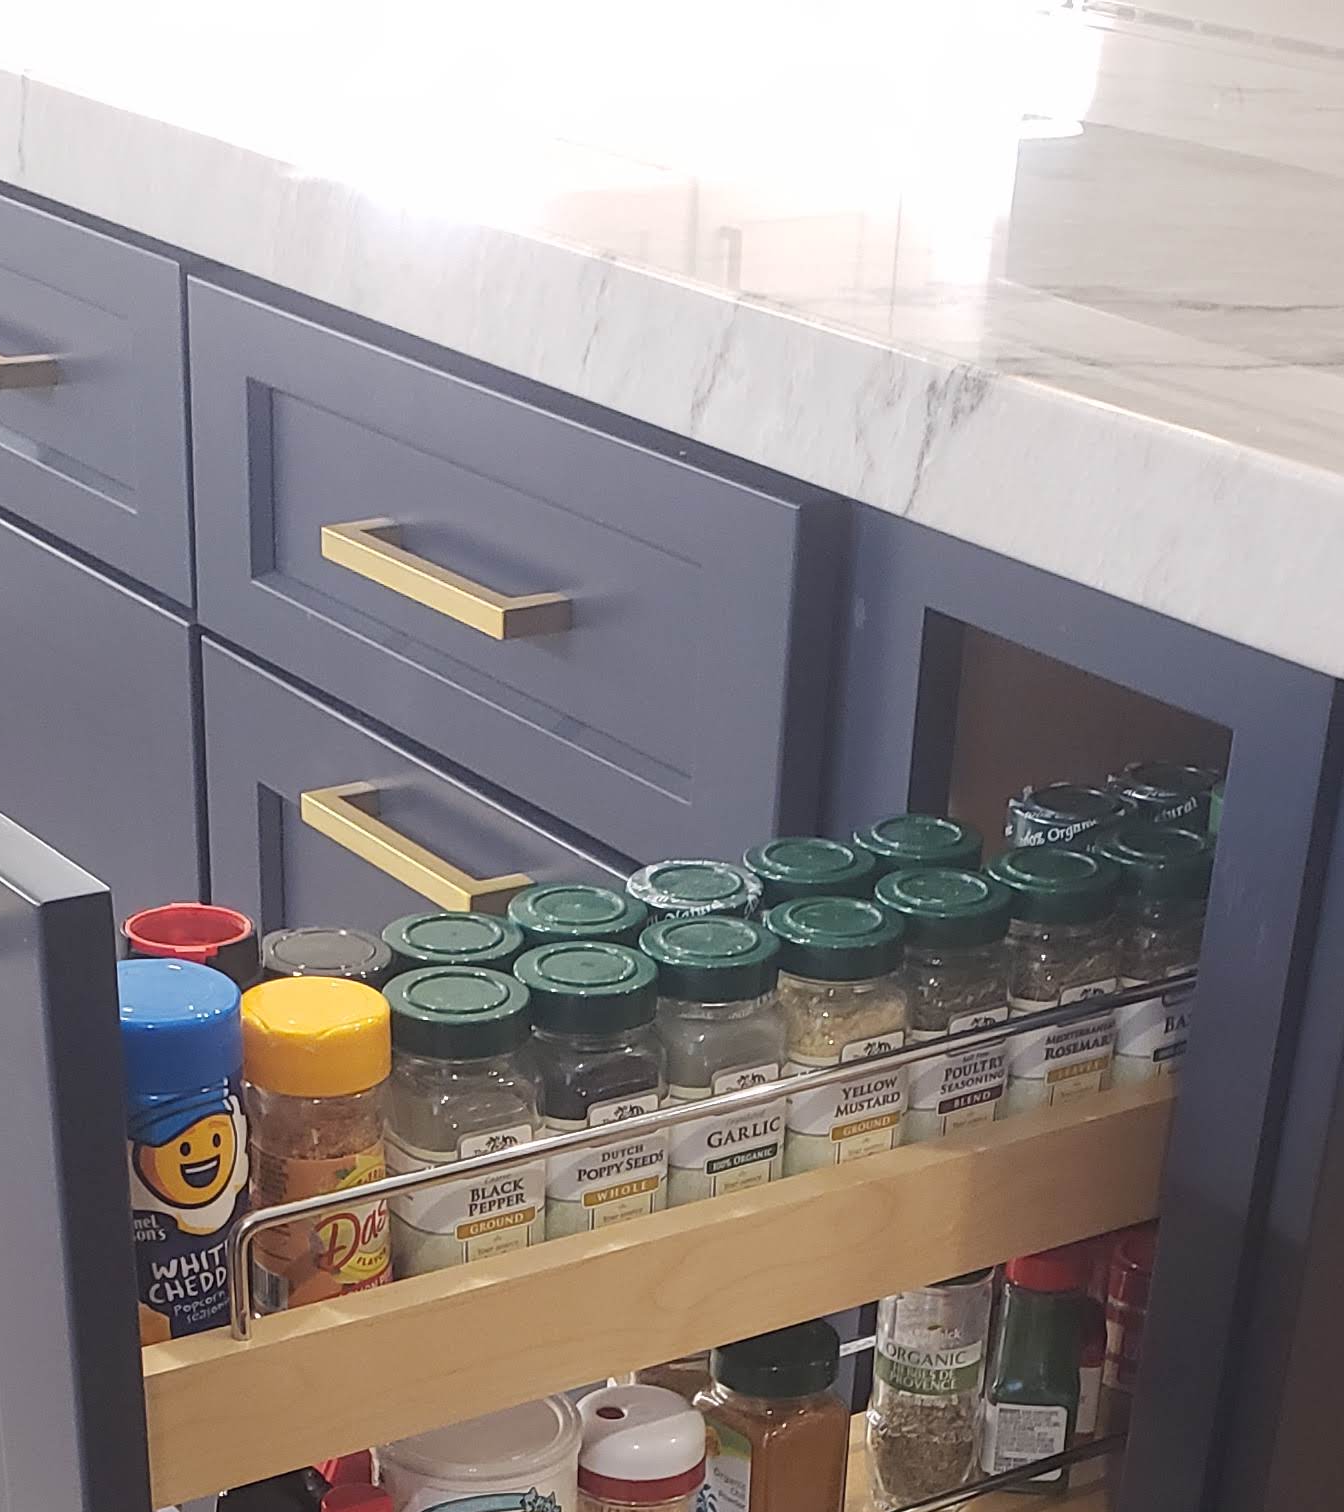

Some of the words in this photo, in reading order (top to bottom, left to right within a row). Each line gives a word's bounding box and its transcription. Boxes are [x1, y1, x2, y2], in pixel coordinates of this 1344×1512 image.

[1164, 1013, 1189, 1034] BA
[944, 1055, 1006, 1082] POULTRY
[842, 1076, 898, 1101] YELLOW
[940, 1070, 1005, 1095] SEASONING
[835, 1092, 901, 1118] MUSTARD
[707, 1117, 781, 1149] GARLIC
[843, 1116, 891, 1136] GROUND
[577, 1162, 624, 1182] POPPY
[625, 1149, 664, 1172] SEEDS
[602, 1145, 644, 1163] DUTCH
[734, 1147, 774, 1167] ORGANIC
[470, 1177, 526, 1203] BLACK
[596, 1181, 647, 1202] WHOLE
[468, 1192, 527, 1217] PEPPER
[469, 1212, 525, 1236] GROUND
[148, 1266, 227, 1304] CHEDD
[885, 1342, 968, 1367] ORGANIC
